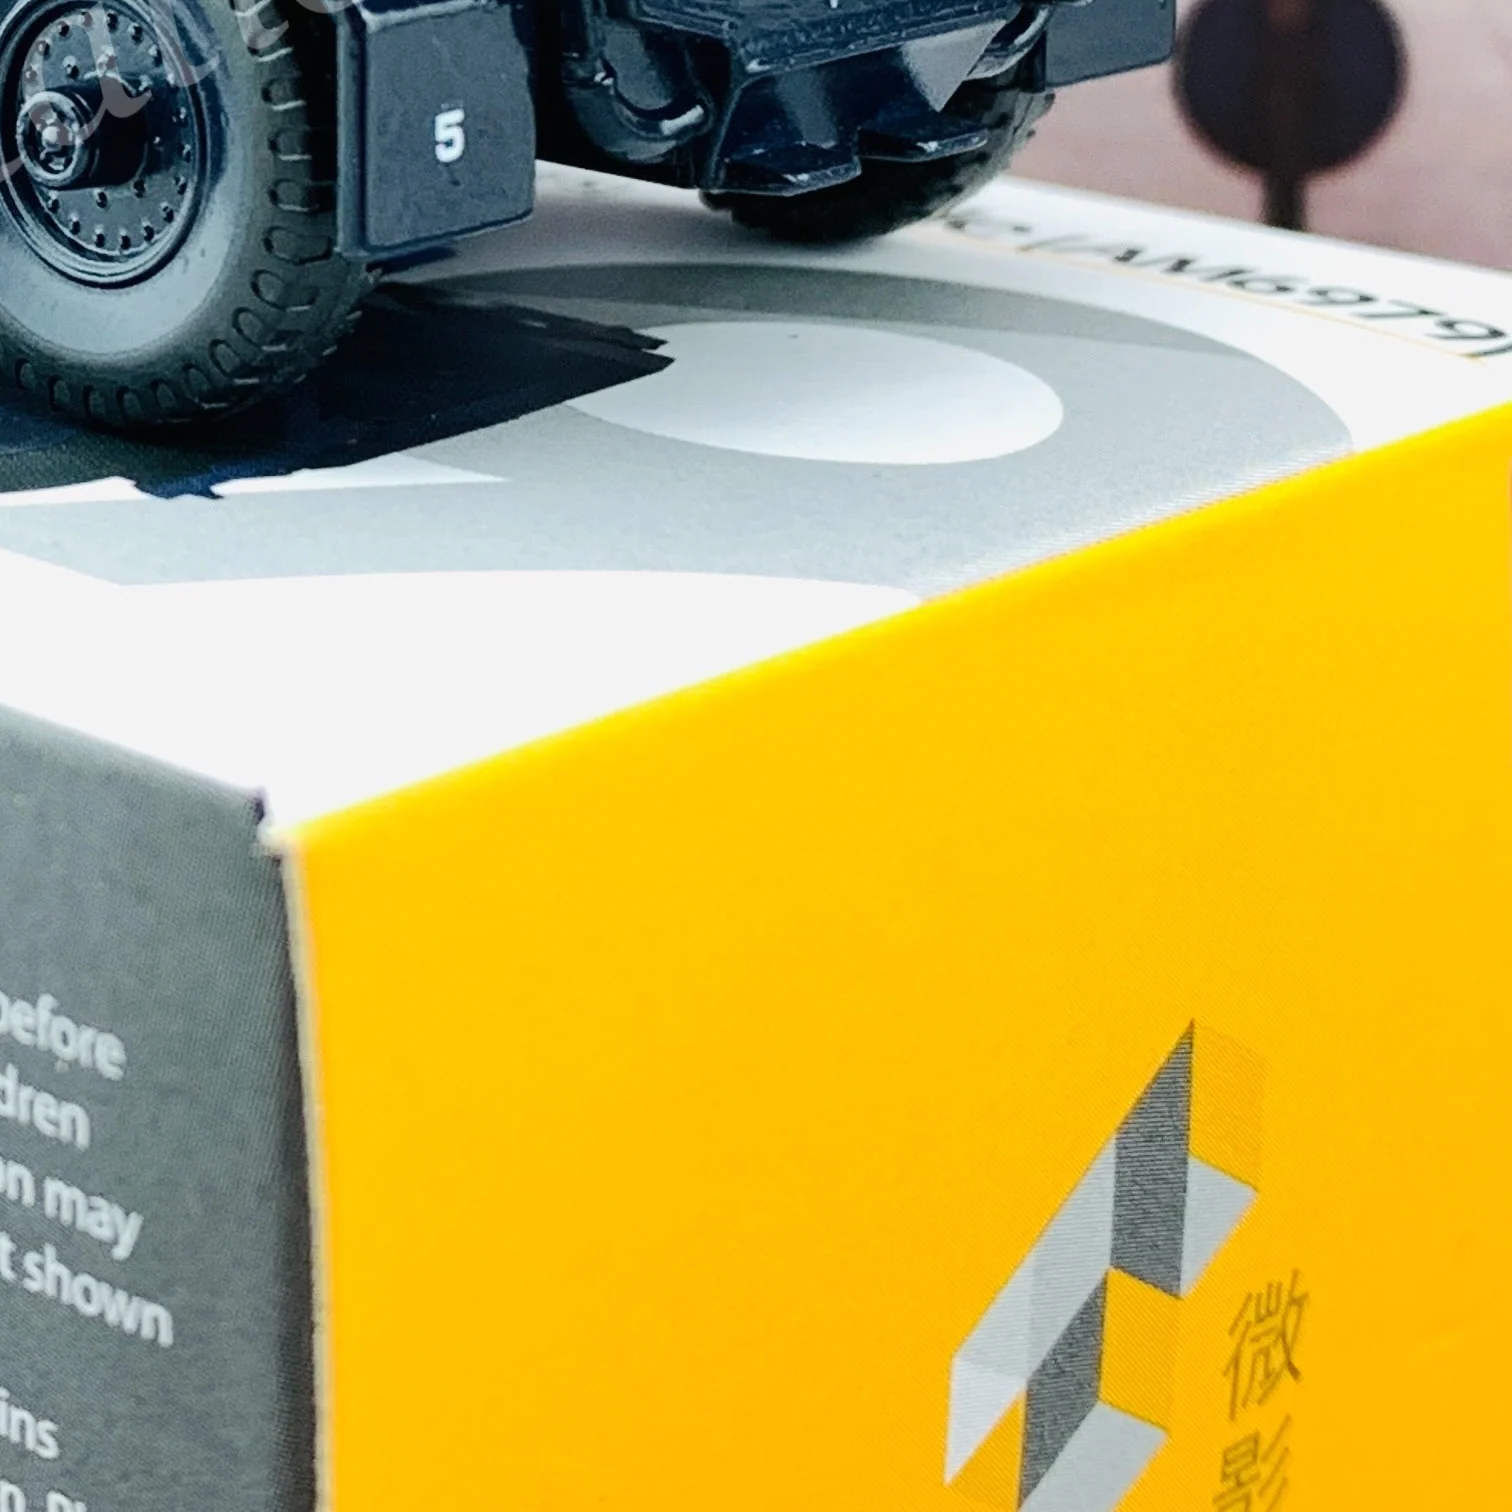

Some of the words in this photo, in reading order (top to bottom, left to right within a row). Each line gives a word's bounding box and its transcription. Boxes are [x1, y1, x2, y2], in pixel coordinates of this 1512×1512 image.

[434, 107, 465, 163] 5
[43, 1174, 144, 1261] may
[23, 1243, 173, 1347] shown
